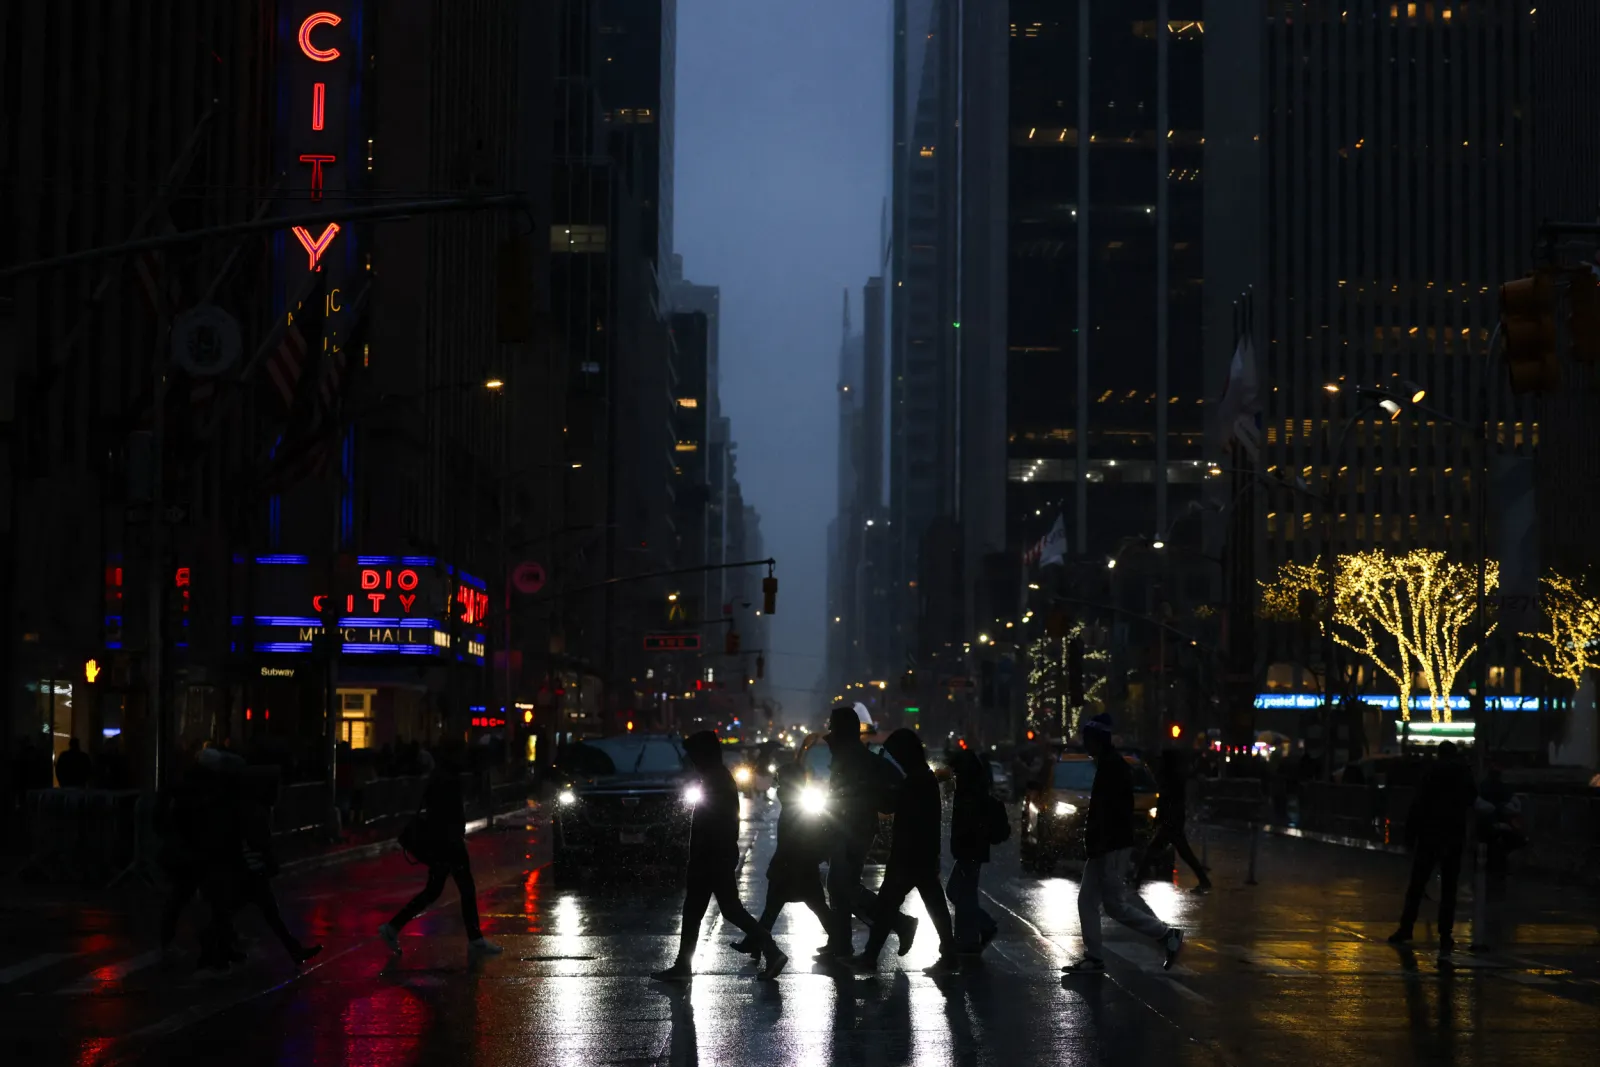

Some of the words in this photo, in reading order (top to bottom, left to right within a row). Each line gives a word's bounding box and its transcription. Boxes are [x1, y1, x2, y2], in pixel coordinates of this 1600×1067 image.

[292, 11, 342, 273] CITY
[361, 569, 419, 591] DIO
[313, 594, 416, 613] CITY
[369, 629, 416, 643] HALL
[261, 667, 295, 677] Subway
